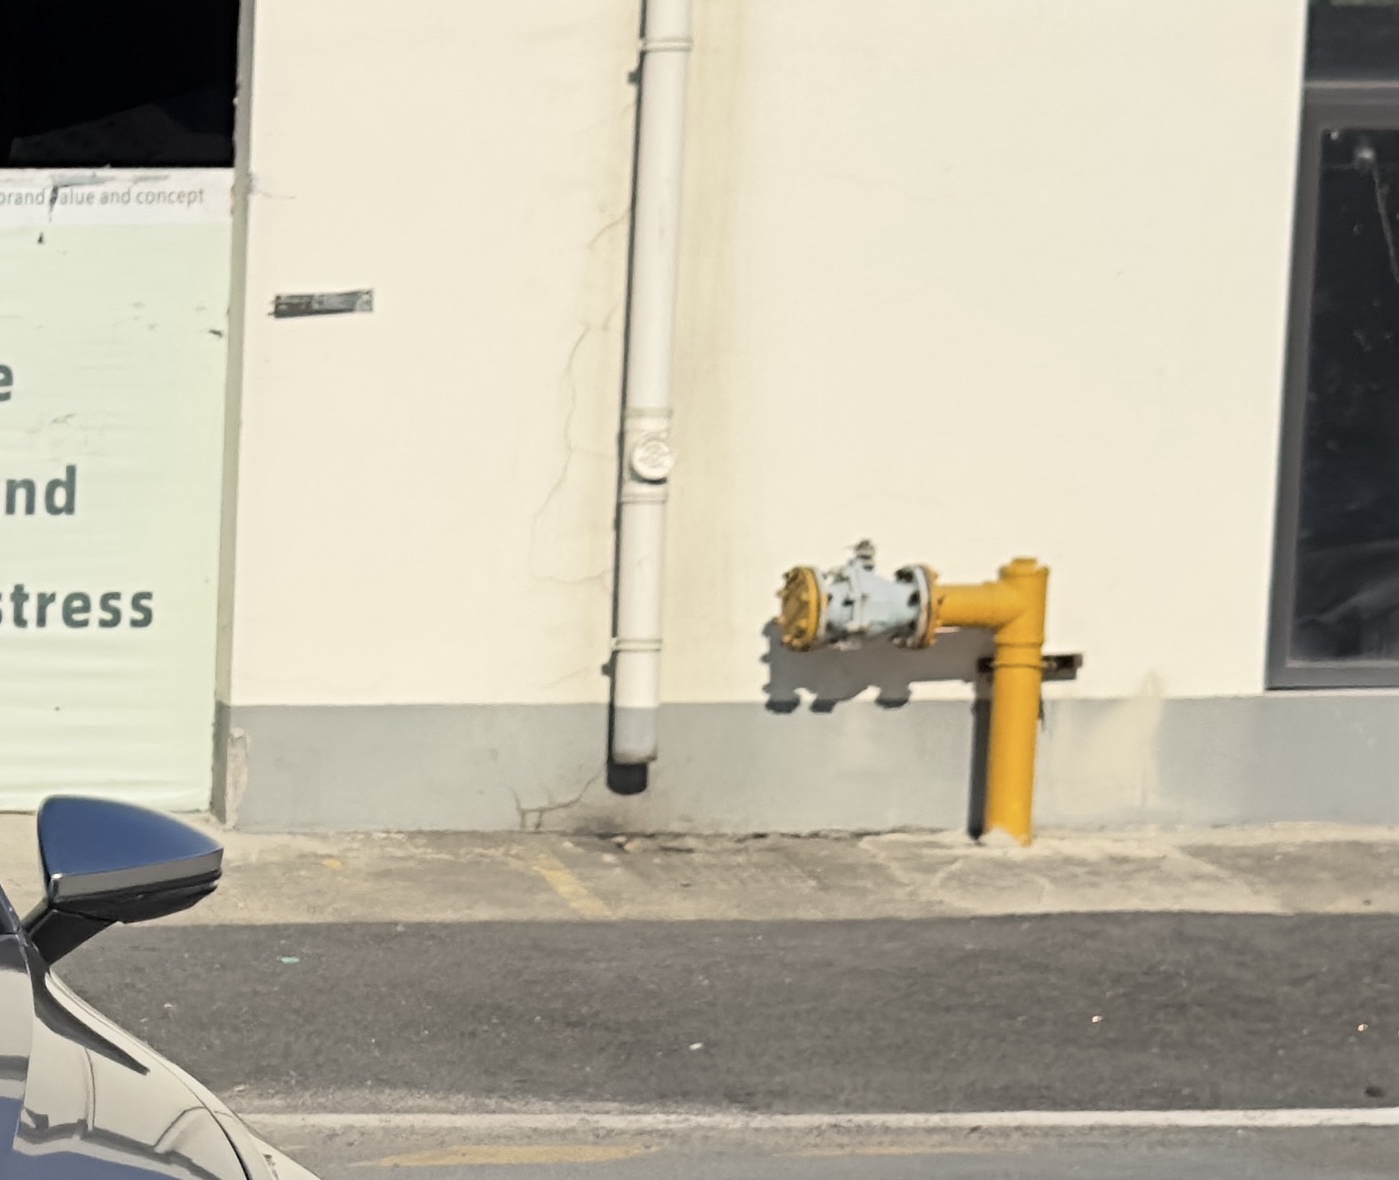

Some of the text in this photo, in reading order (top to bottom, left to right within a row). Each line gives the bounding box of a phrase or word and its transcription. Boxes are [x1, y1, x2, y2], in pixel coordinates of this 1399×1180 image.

[51, 187, 95, 207] alue
[99, 187, 131, 206] and
[135, 187, 205, 210] concept
